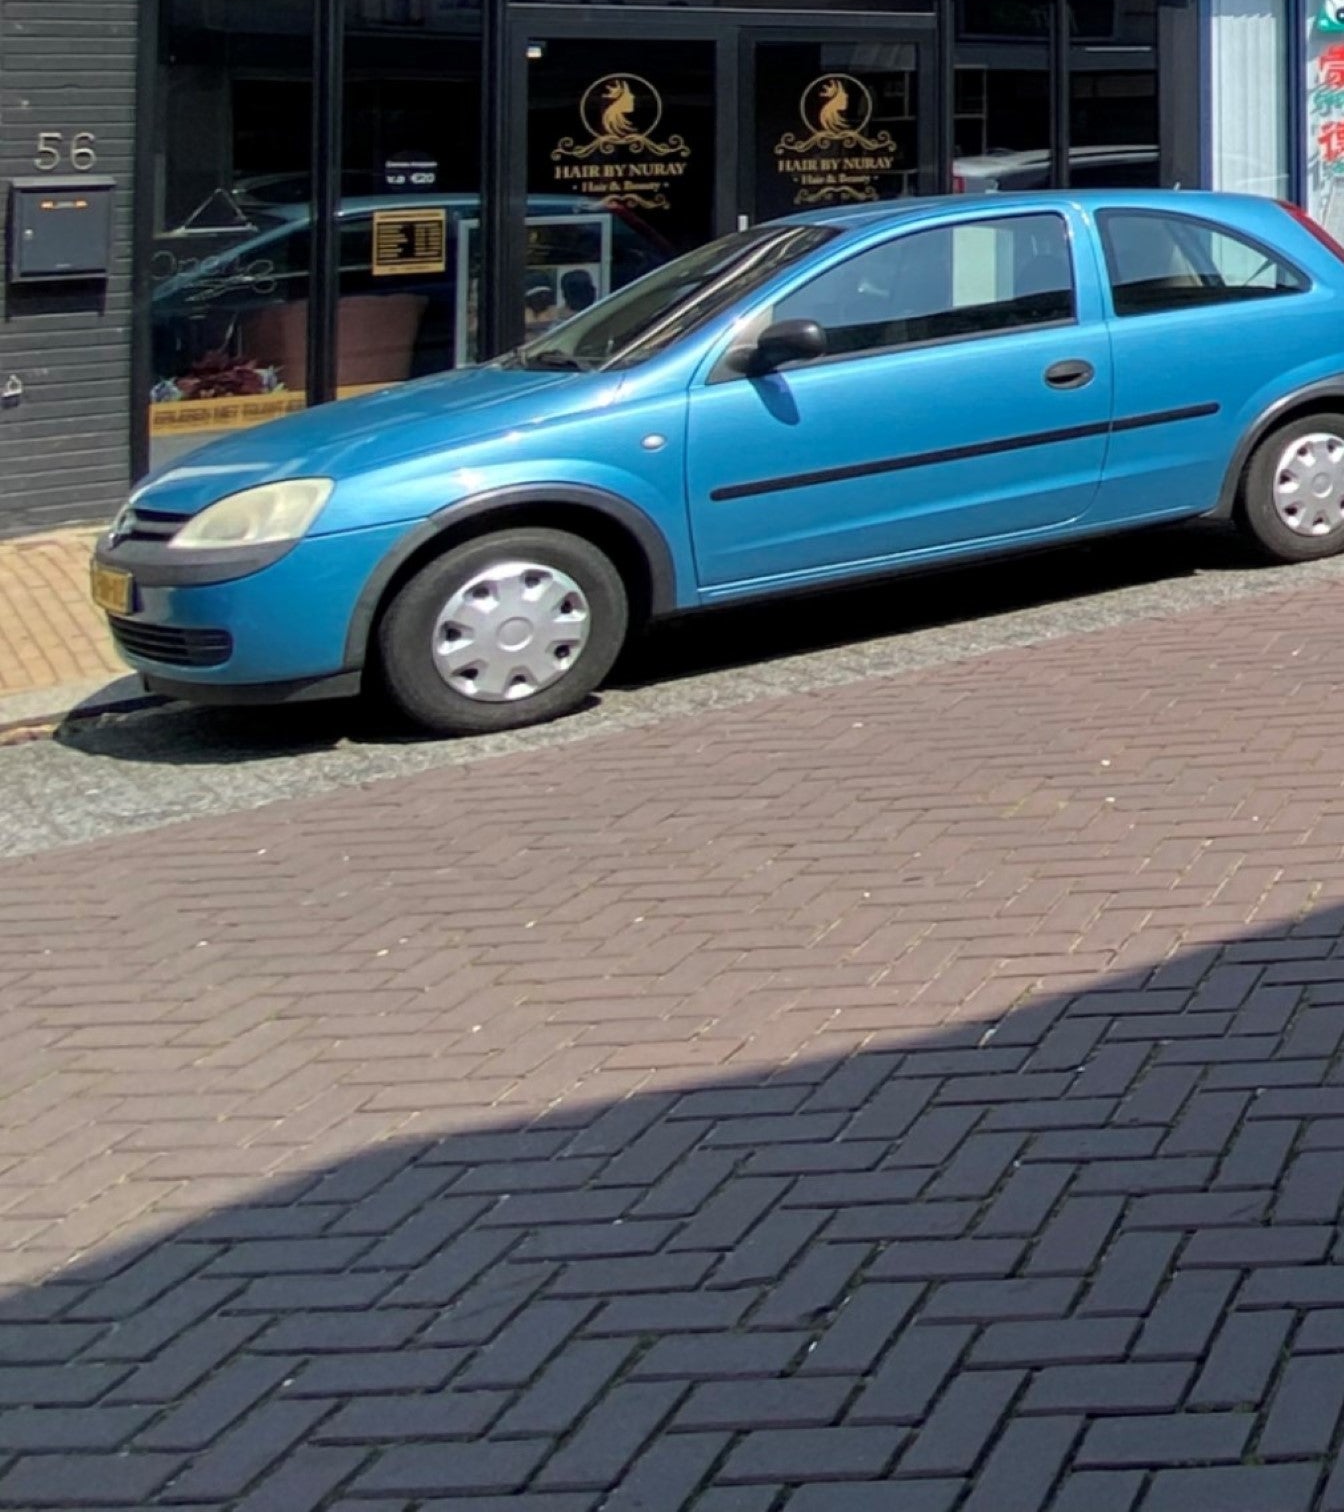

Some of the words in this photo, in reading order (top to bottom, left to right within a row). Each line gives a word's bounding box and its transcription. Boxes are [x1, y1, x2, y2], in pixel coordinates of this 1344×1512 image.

[34, 133, 97, 170] 56
[554, 165, 600, 179] HAIR
[602, 164, 625, 178] BY
[627, 162, 687, 177] NURAY
[777, 159, 818, 172] HAIR
[820, 158, 840, 170] BY
[842, 156, 894, 169] NURAY
